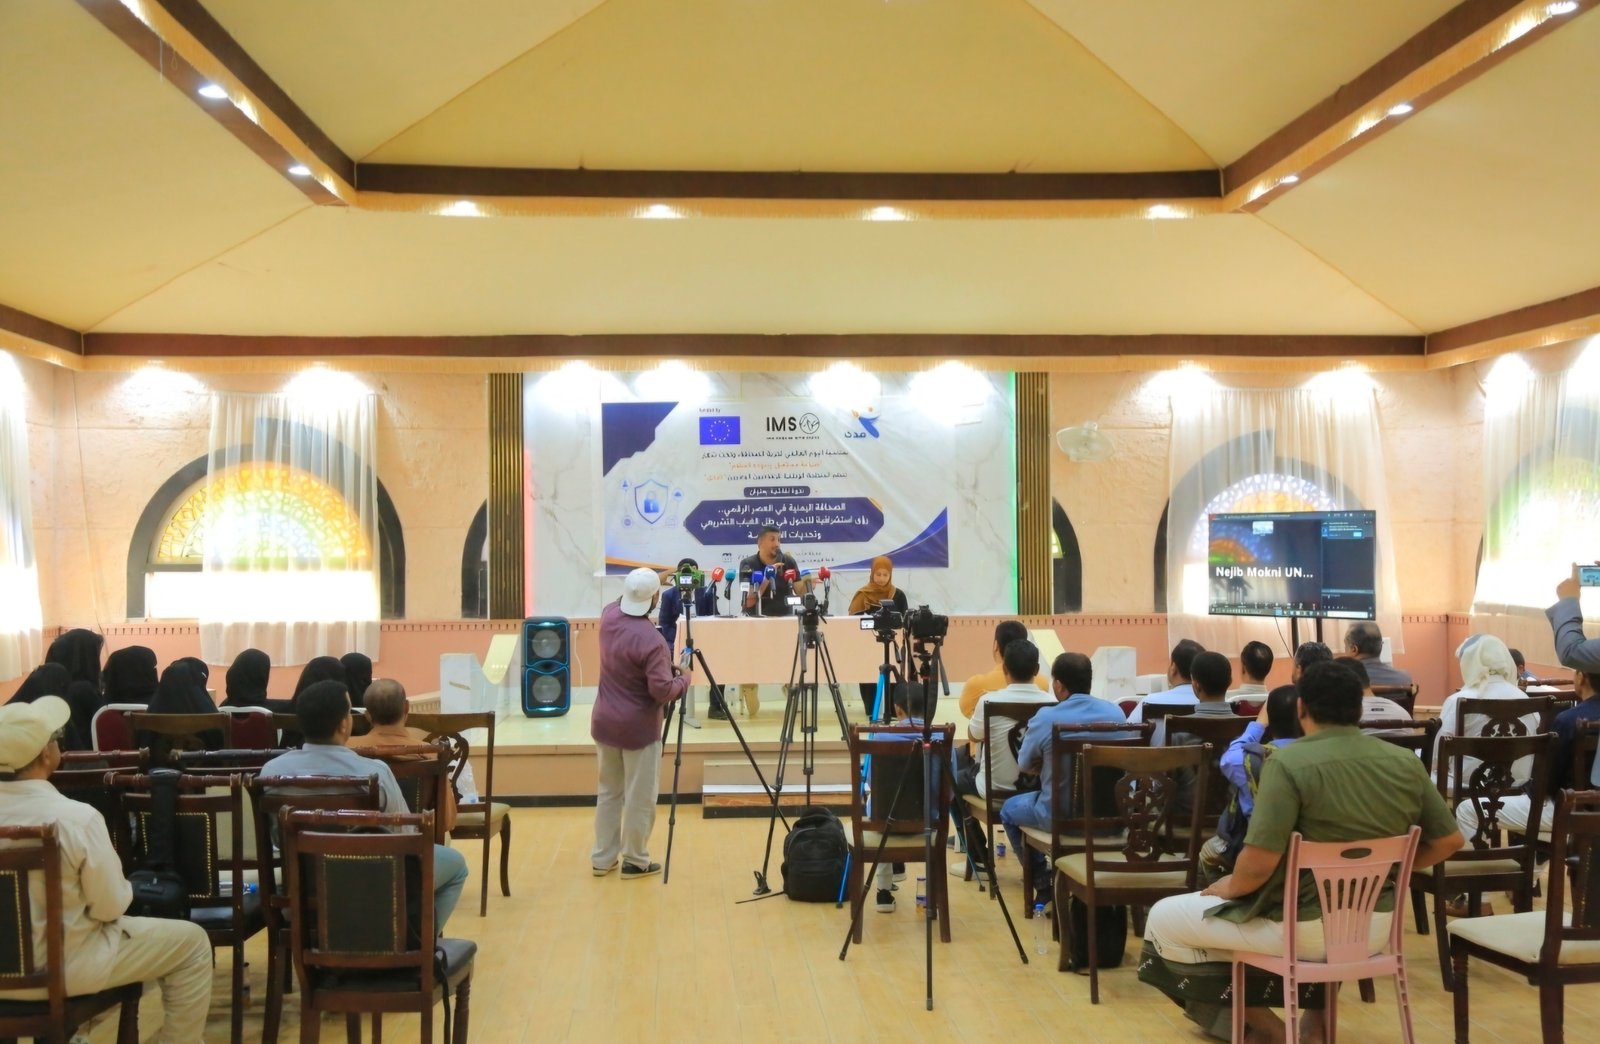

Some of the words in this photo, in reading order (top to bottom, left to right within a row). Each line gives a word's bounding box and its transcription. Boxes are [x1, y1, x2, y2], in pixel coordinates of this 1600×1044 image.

[766, 416, 797, 431] IMS
[751, 504, 774, 515] العصر
[774, 503, 787, 515] في
[788, 503, 814, 514] اليمنية
[815, 502, 846, 511] الصحافة
[775, 517, 788, 528] في
[788, 530, 822, 541] وتحديات
[1215, 566, 1244, 579] Nejib
[1247, 566, 1281, 578] Mokni
[1285, 567, 1314, 579] UN...
